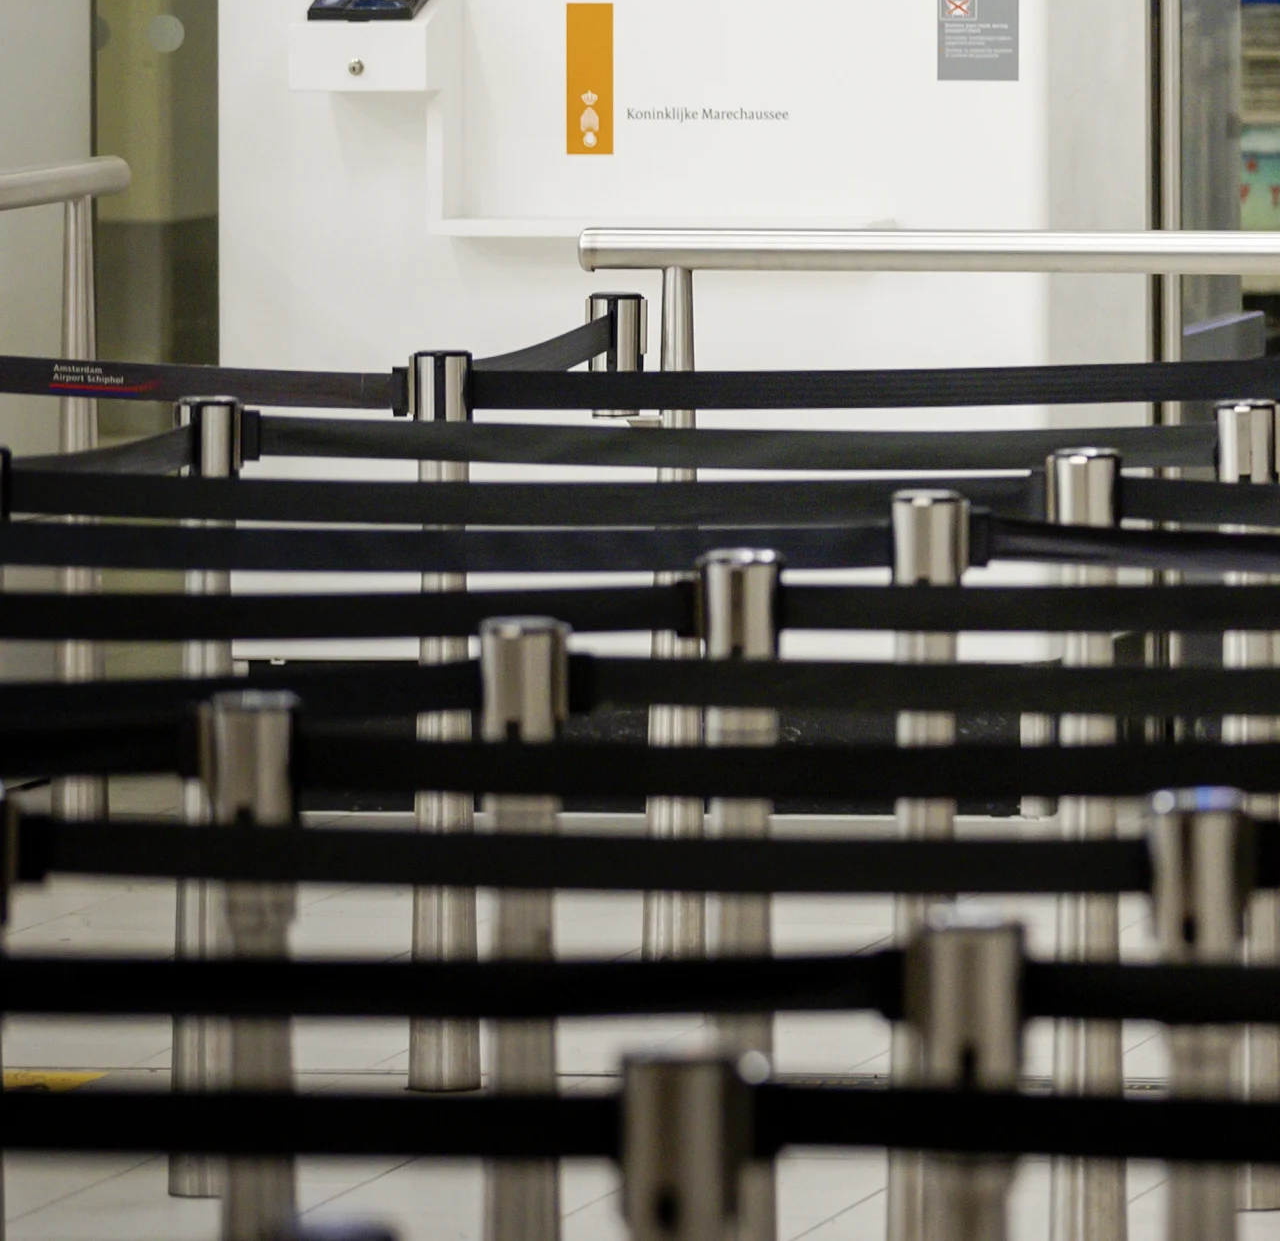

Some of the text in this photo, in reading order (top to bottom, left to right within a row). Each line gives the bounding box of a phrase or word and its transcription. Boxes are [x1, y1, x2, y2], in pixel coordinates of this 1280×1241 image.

[627, 107, 788, 123] Koninklijke Marechaussee
[54, 364, 102, 374] Amsterdam
[53, 373, 124, 384] Airport Schiphol
